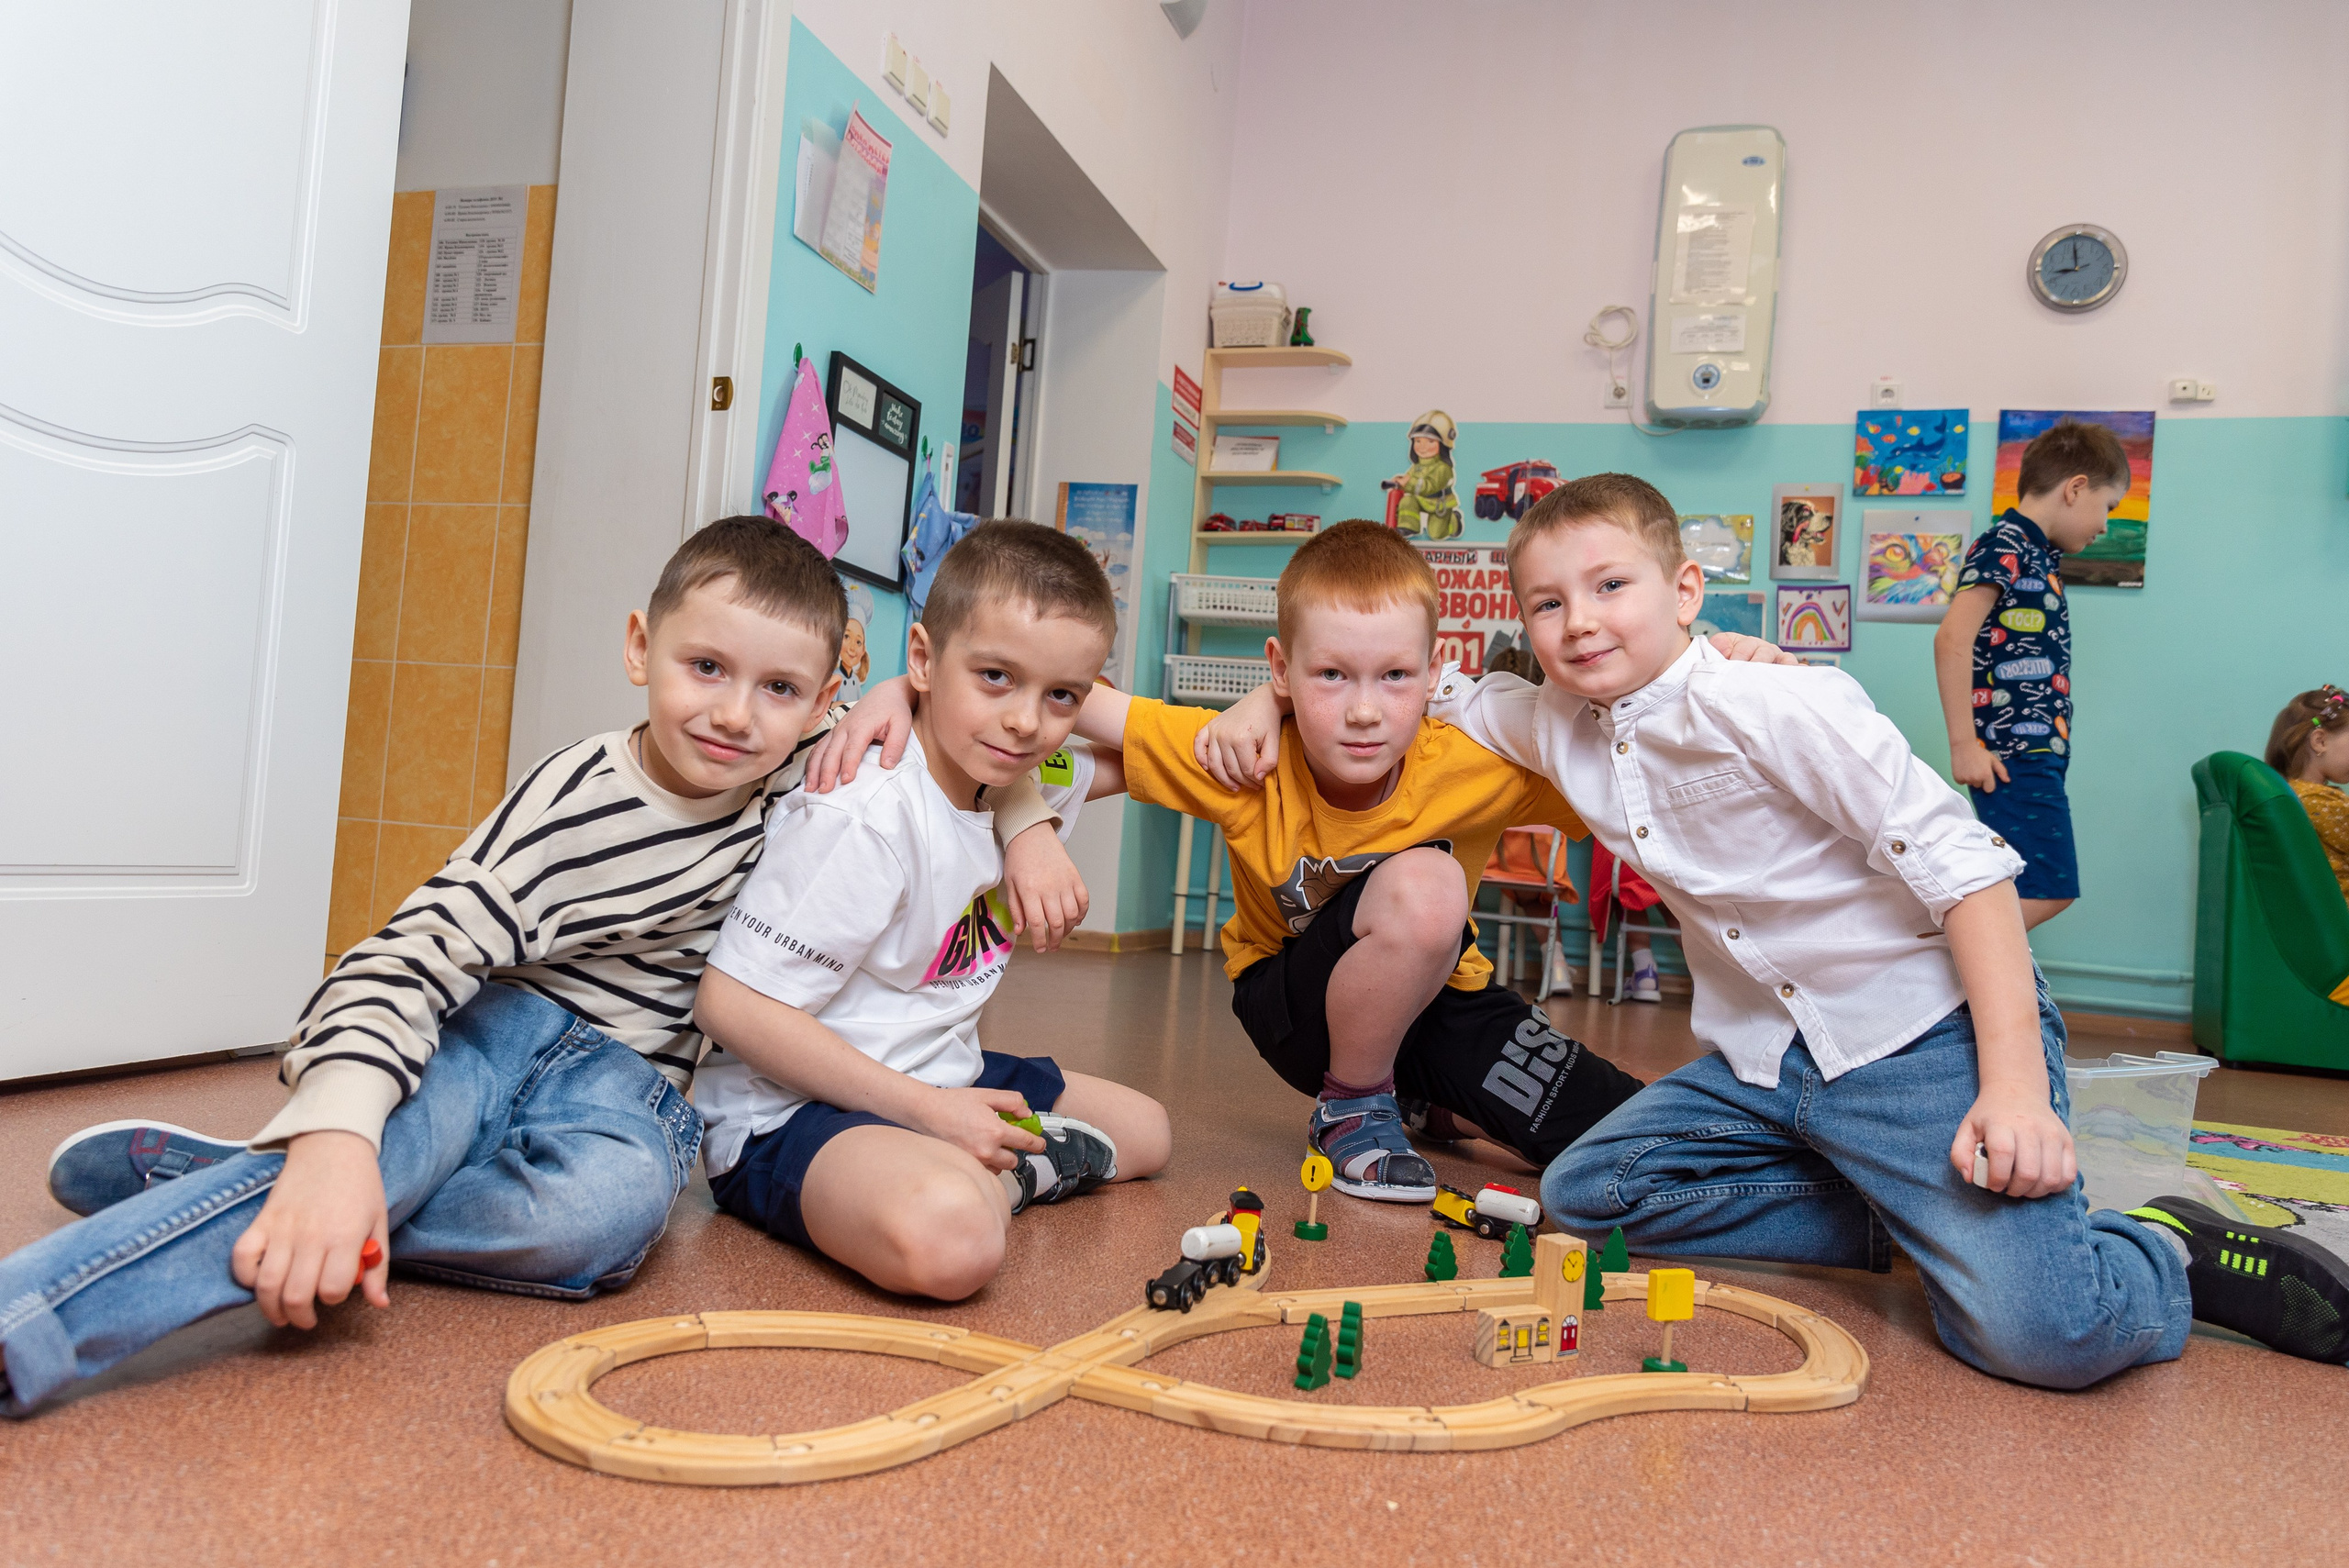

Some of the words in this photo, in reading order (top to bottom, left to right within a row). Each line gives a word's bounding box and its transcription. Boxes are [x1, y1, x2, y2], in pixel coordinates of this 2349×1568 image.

[1422, 550, 1477, 564] АРНЫЙ
[1490, 550, 1508, 565] Щ
[741, 913, 773, 939] YOUR
[774, 932, 815, 961] URBAN
[812, 952, 844, 973] MIND
[965, 967, 998, 987] URBAN
[1530, 1097, 1554, 1134] FASHION
[1549, 1069, 1570, 1098] SPORT
[1564, 1051, 1577, 1071] KIDS
